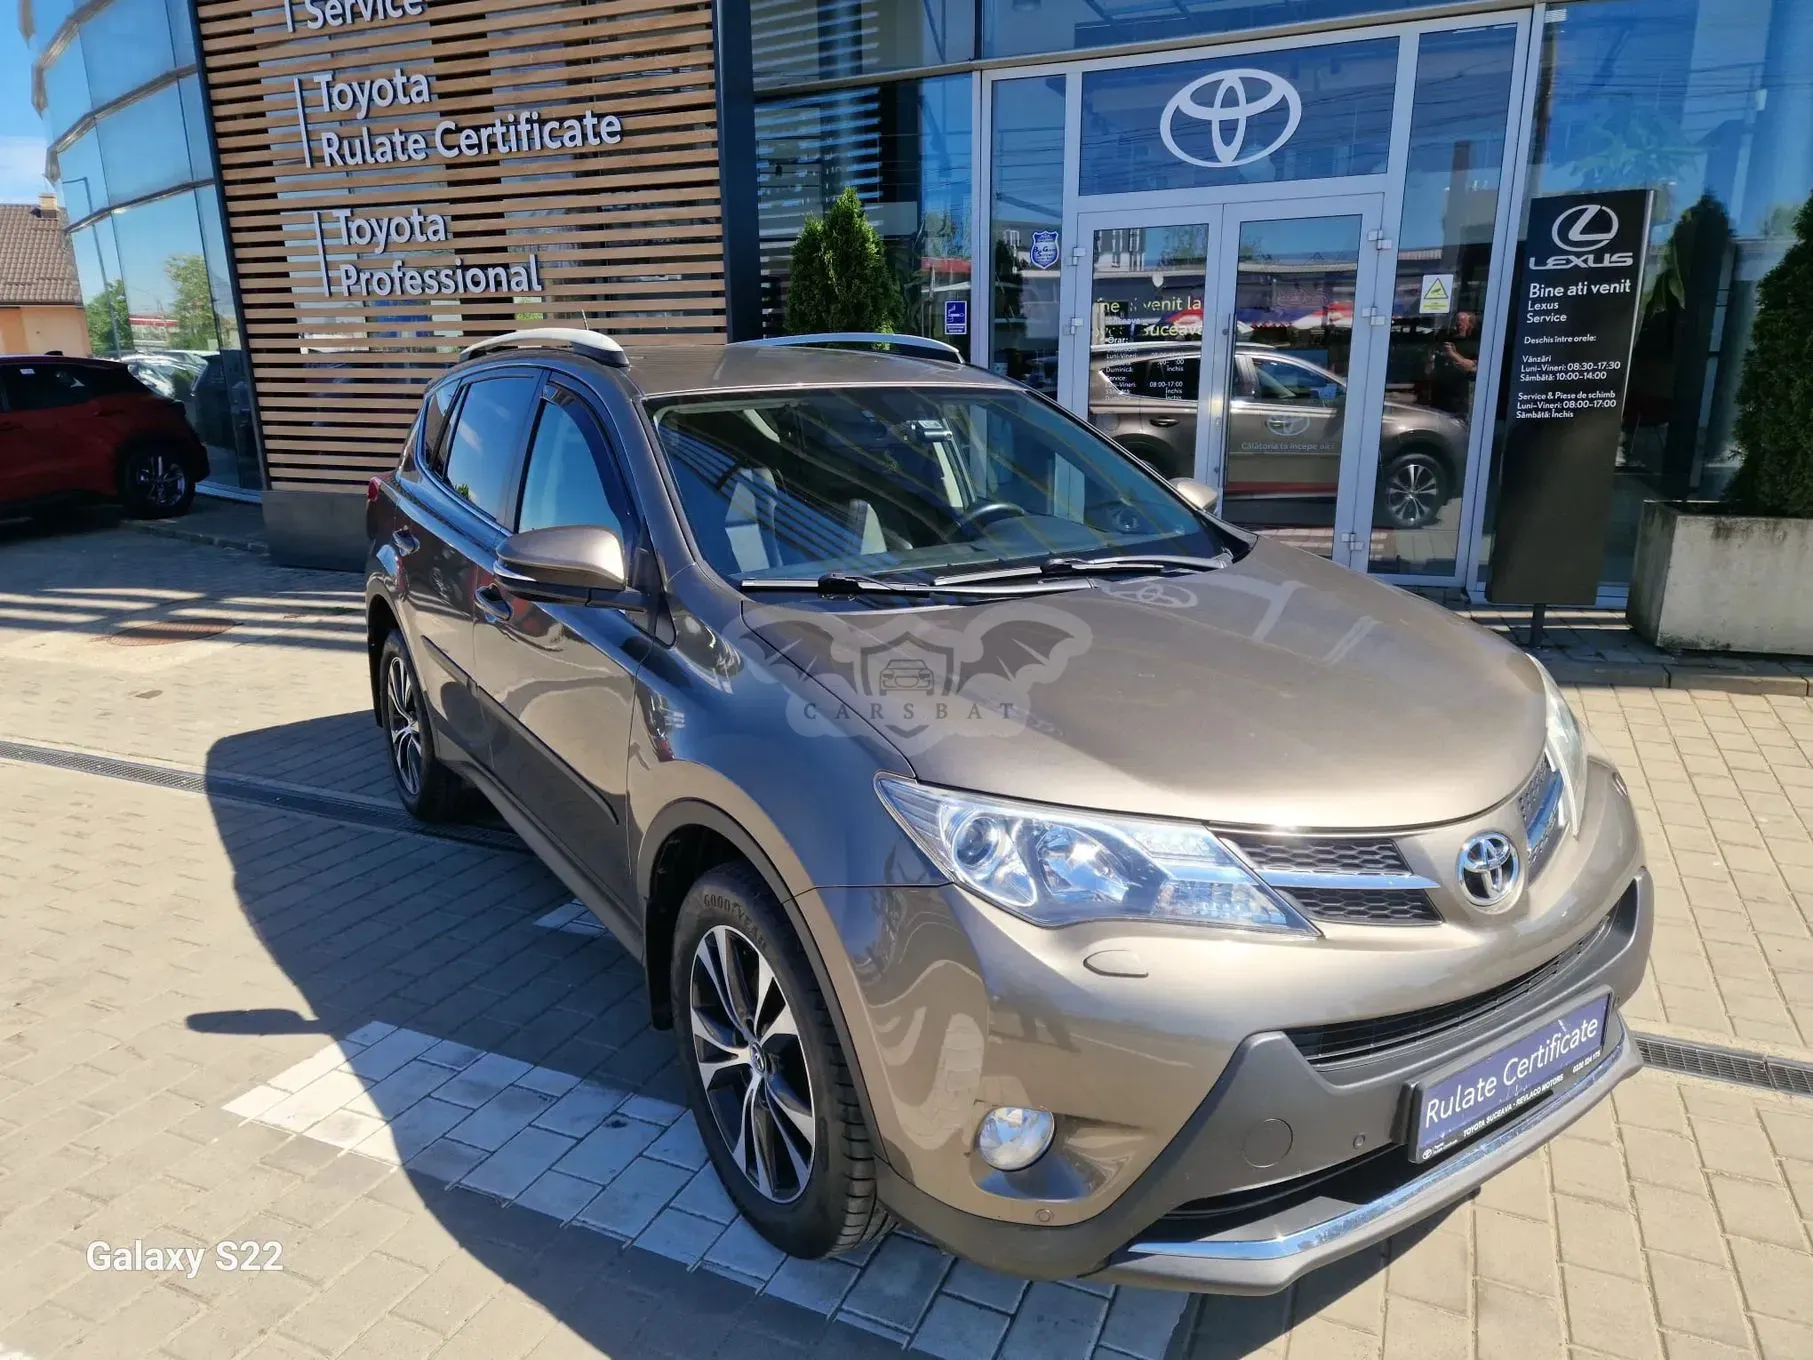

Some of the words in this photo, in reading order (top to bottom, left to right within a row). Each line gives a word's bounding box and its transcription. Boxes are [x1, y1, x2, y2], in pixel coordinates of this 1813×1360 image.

[304, 0, 423, 30] Service
[313, 69, 431, 120] Toyota
[321, 126, 428, 167] Rulate
[435, 109, 622, 158] Certificate
[332, 208, 447, 254] Toyota
[1529, 252, 1633, 270] LEXUS
[339, 254, 542, 297] Professional
[1529, 282, 1564, 298] Bine
[1567, 281, 1588, 296] ati
[1591, 279, 1631, 294] venit
[1528, 300, 1559, 311] Lexus
[1526, 312, 1567, 324] Service
[1524, 335, 1554, 344] Deschis
[1574, 333, 1597, 342] orele:
[1521, 363, 1566, 372] Luni-Vineri:
[1567, 361, 1621, 371] 08:30-17:30
[1556, 371, 1607, 380] 10:00-14:00
[1518, 392, 1546, 400] Service
[1547, 391, 1554, 400] &
[1555, 391, 1576, 399] Piese
[1577, 390, 1587, 399] de
[1588, 390, 1616, 399] schimb
[1517, 401, 1562, 410] Luni-Vineri:
[1563, 399, 1617, 408] 08:00-17:00
[1426, 1076, 1497, 1129] Rulate
[1503, 1017, 1598, 1086] Certificate
